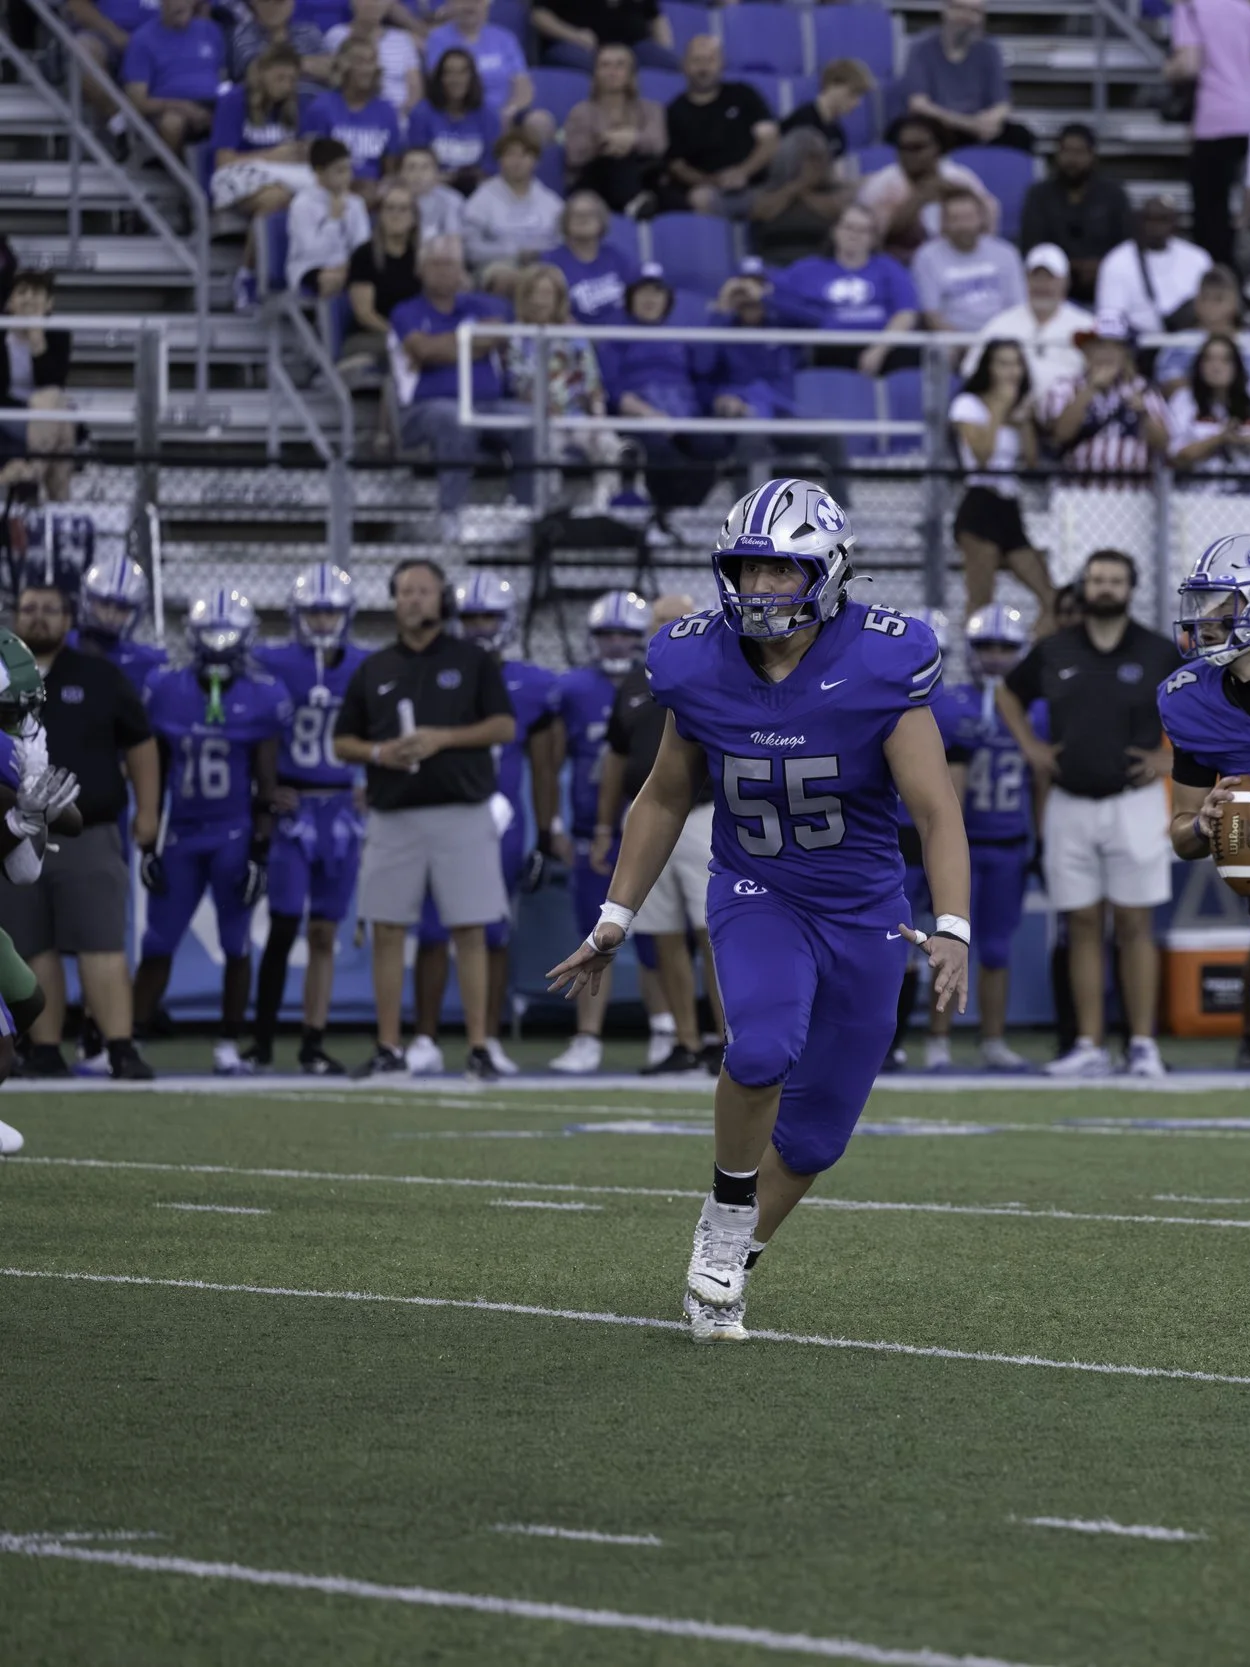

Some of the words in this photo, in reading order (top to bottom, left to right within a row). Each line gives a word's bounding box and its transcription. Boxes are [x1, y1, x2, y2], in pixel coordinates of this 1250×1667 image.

[740, 536, 768, 548] Vikings
[750, 731, 806, 748] Vikings
[180, 736, 231, 799] 16
[722, 753, 847, 858] 55
[1228, 813, 1241, 856] Wilson
